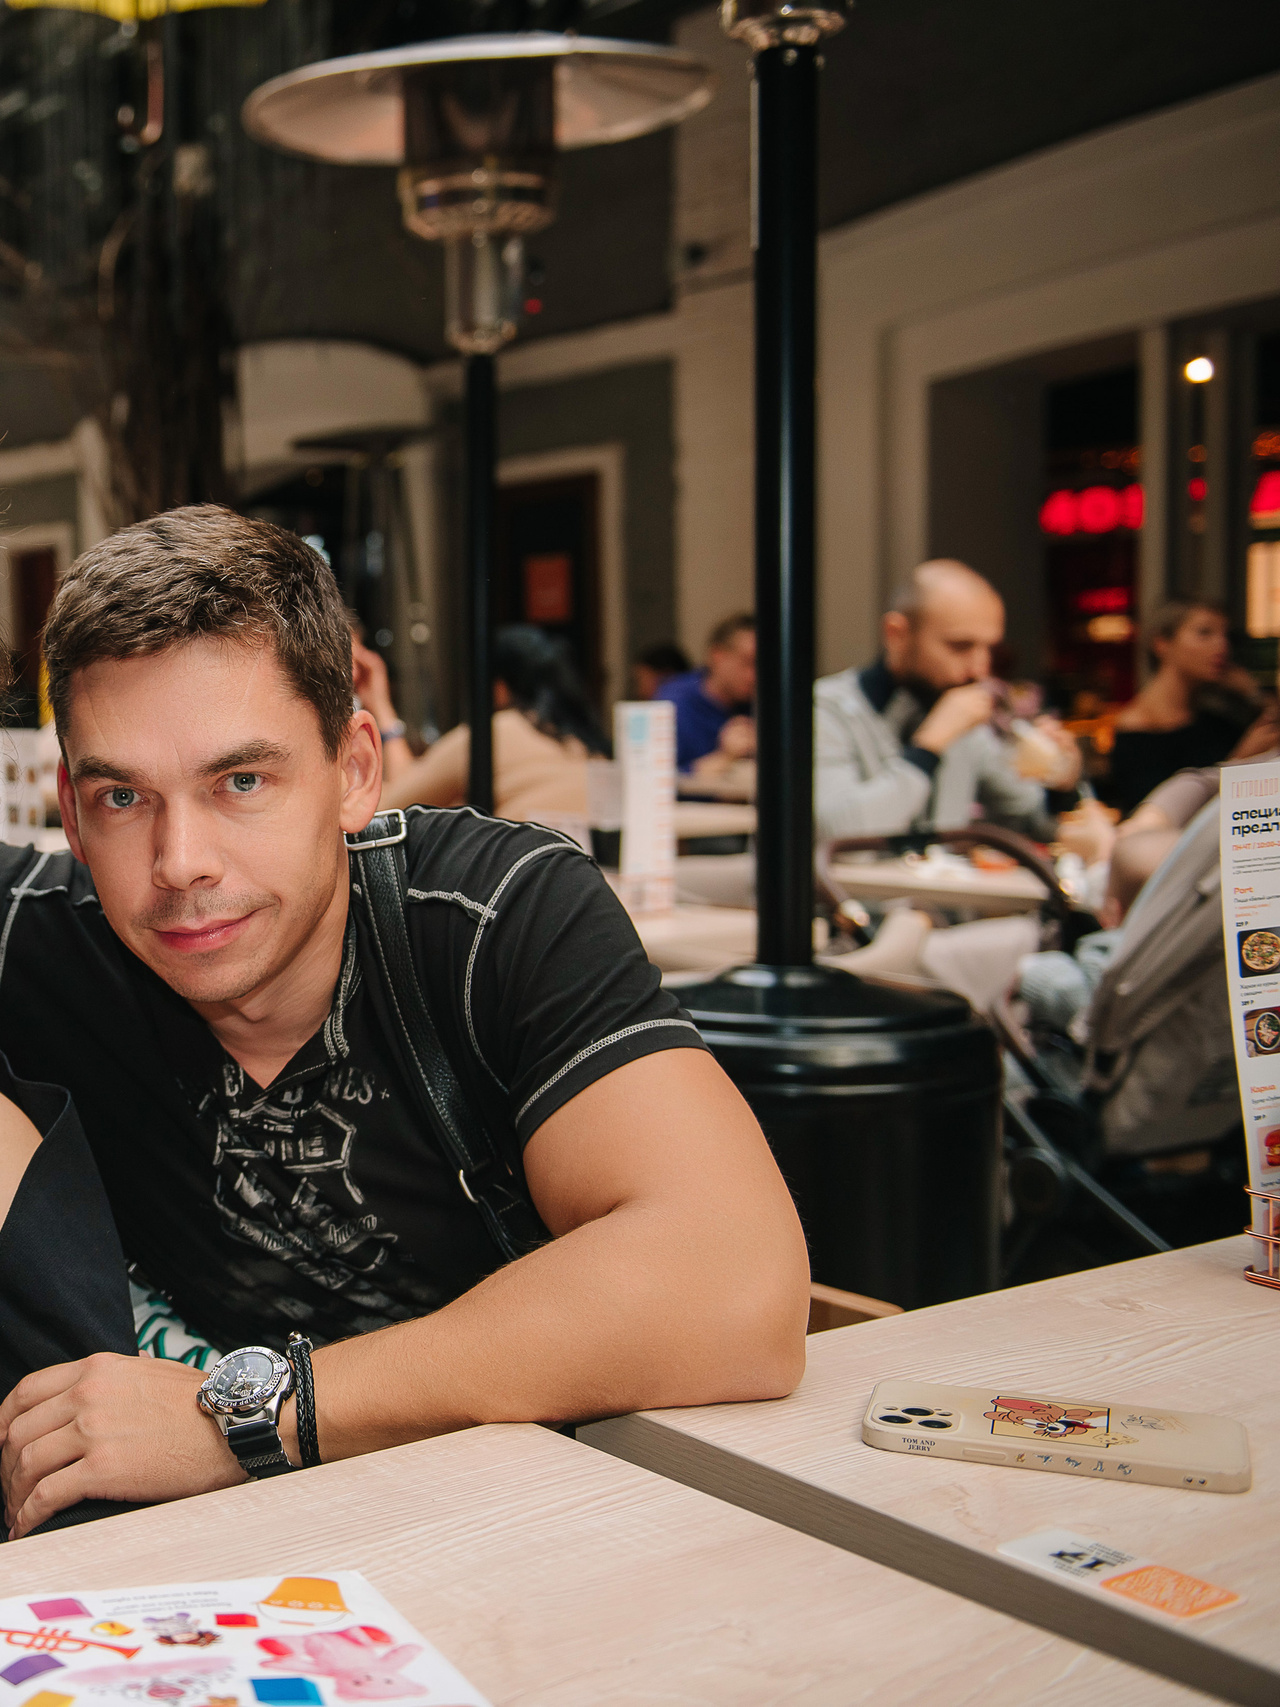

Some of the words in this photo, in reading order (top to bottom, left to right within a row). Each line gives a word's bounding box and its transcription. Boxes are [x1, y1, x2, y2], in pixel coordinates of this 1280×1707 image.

[1231, 807, 1280, 821] специ
[1233, 887, 1254, 895] Port
[901, 1437, 918, 1445] TOM
[908, 1444, 931, 1452] JERRY
